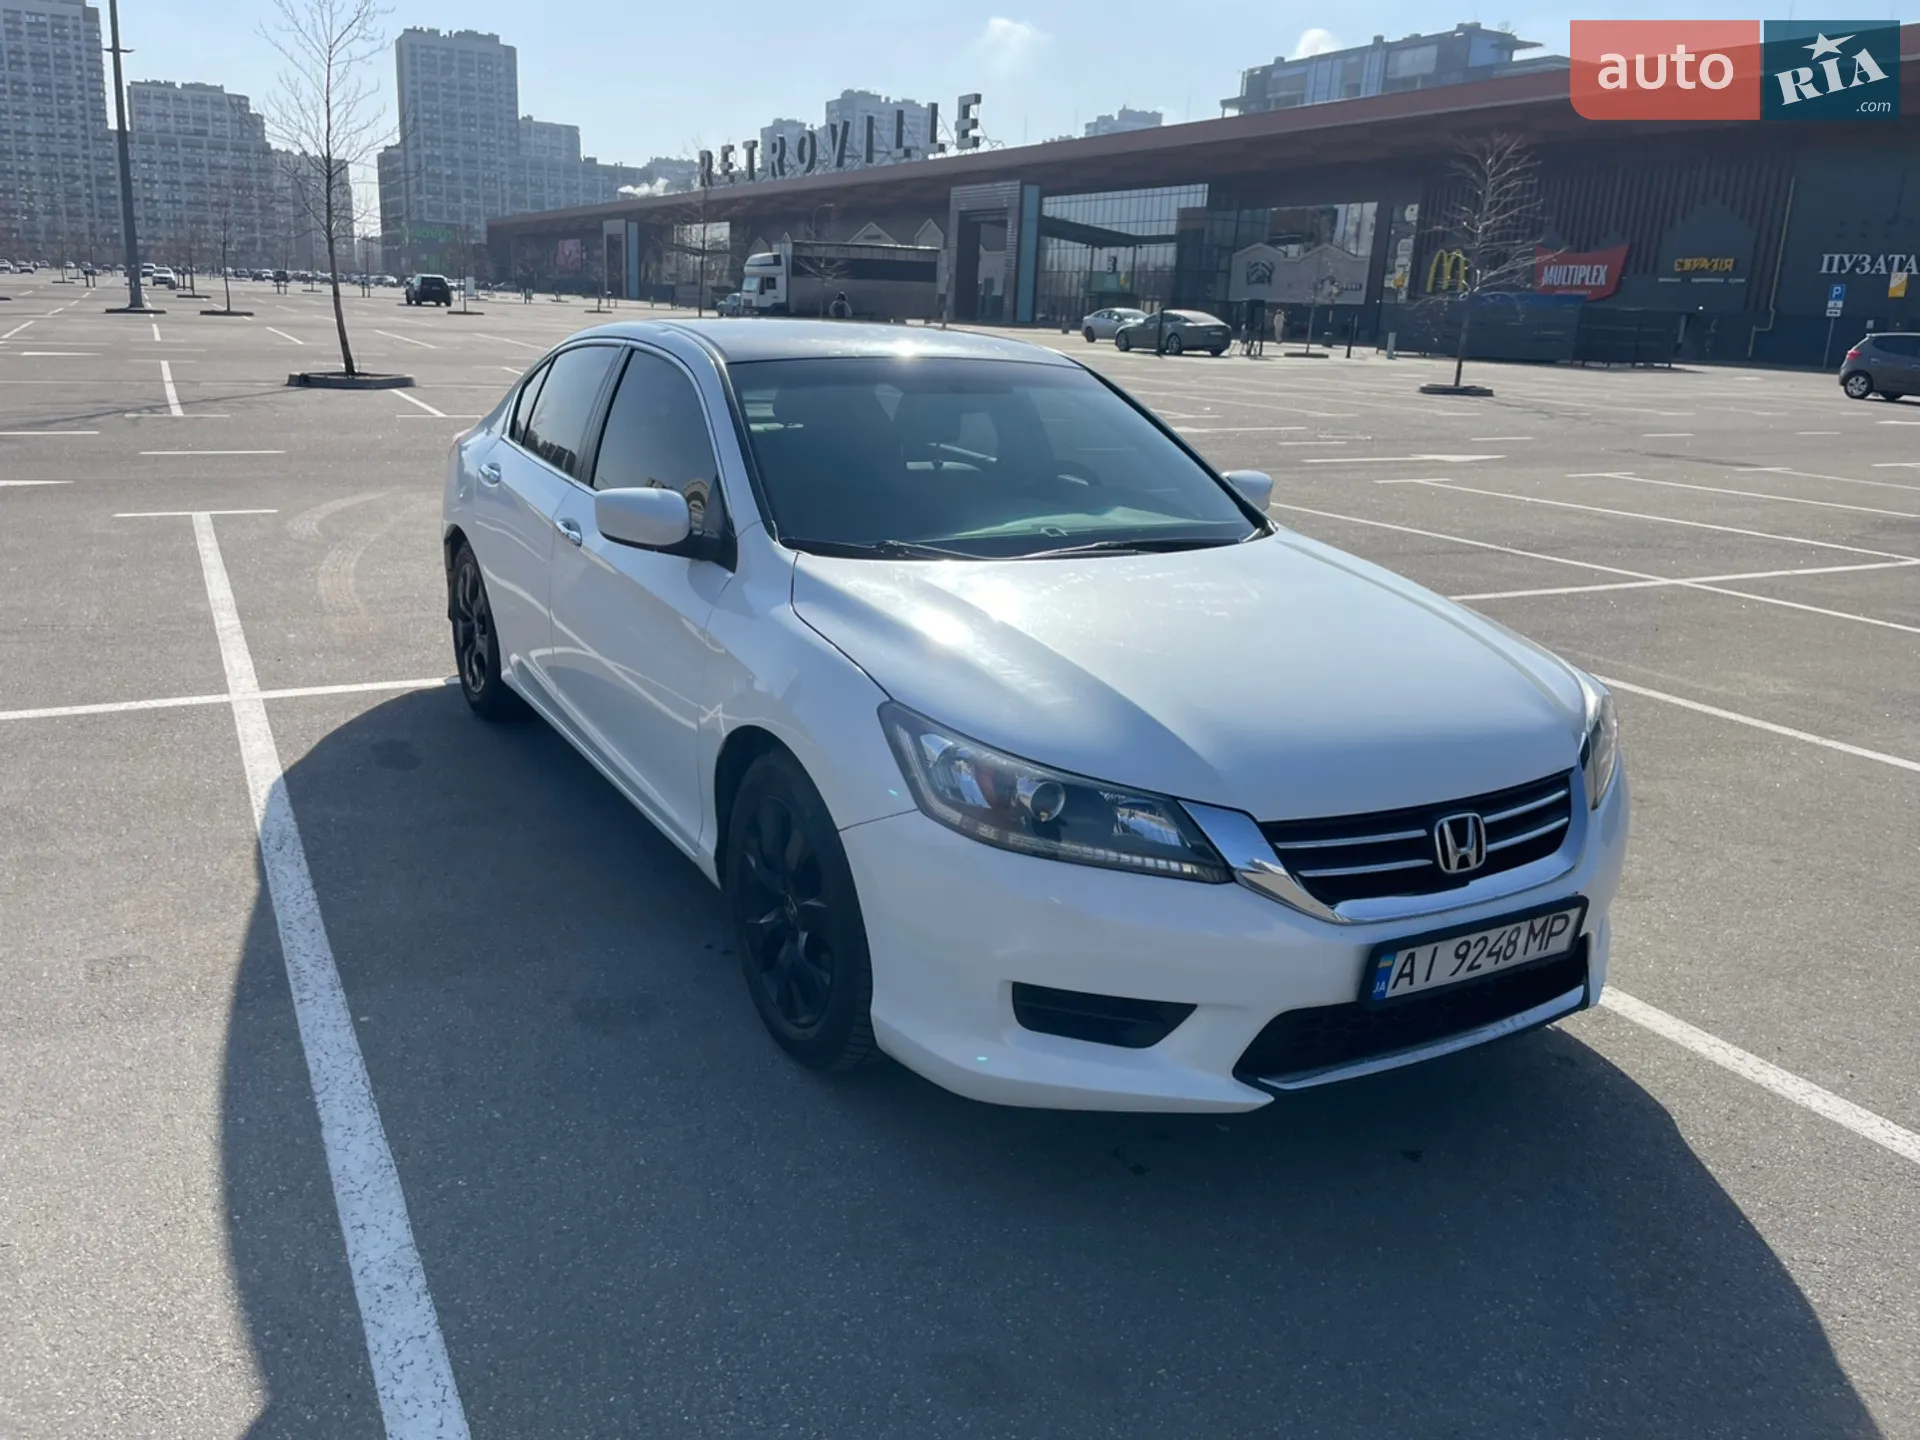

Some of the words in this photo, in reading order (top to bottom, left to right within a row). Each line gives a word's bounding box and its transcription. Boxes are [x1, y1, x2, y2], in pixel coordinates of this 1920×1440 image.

[698, 92, 982, 188] RETROVILLE
[1542, 264, 1608, 286] MULTIPLEX
[1819, 253, 1920, 275] ПУЗАТА
[1391, 945, 1438, 990] AI
[1449, 926, 1521, 977] 9248
[1523, 913, 1571, 957] MP
